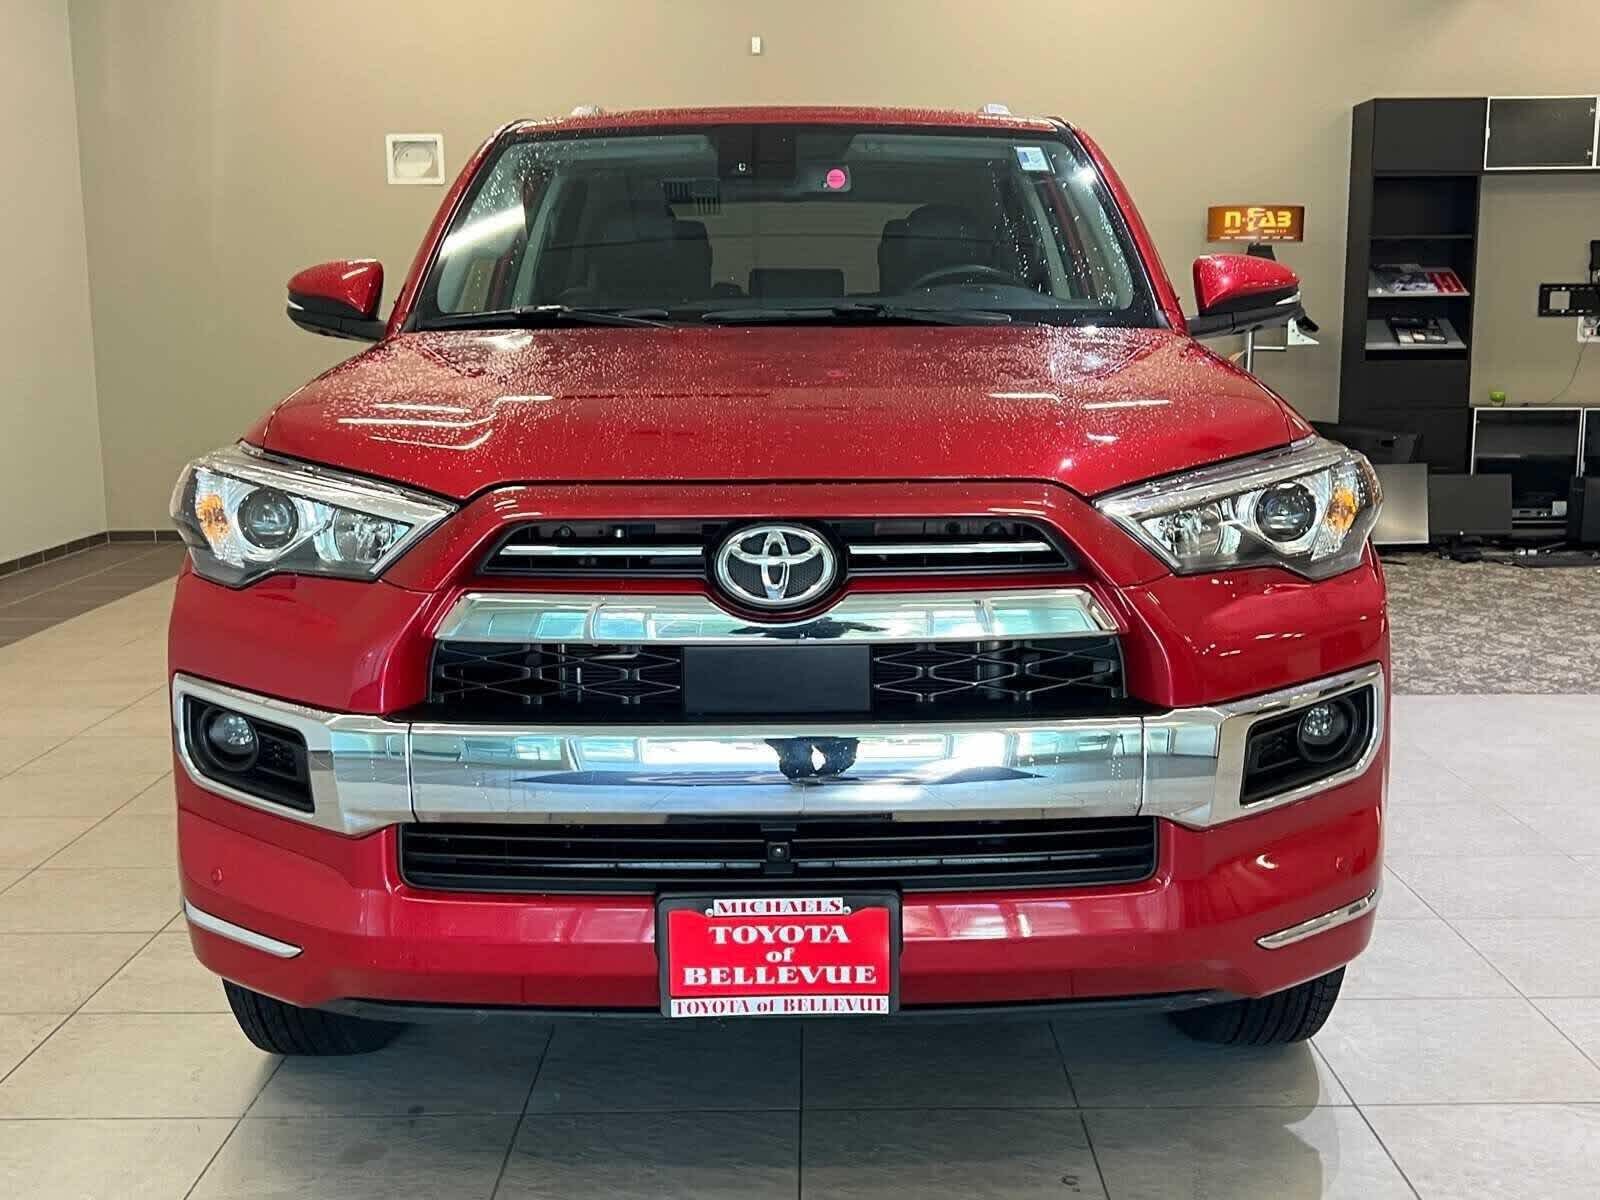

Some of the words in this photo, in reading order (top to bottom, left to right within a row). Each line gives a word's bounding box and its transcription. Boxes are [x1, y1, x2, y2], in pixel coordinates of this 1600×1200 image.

[718, 899, 841, 914] MICHAELS
[708, 925, 850, 944] TOYOTA
[766, 947, 795, 962] of
[683, 966, 877, 986] BELLEVUE
[675, 999, 750, 1015] TOYOTA
[757, 999, 774, 1012] of
[783, 998, 887, 1012] BELLEVUE
